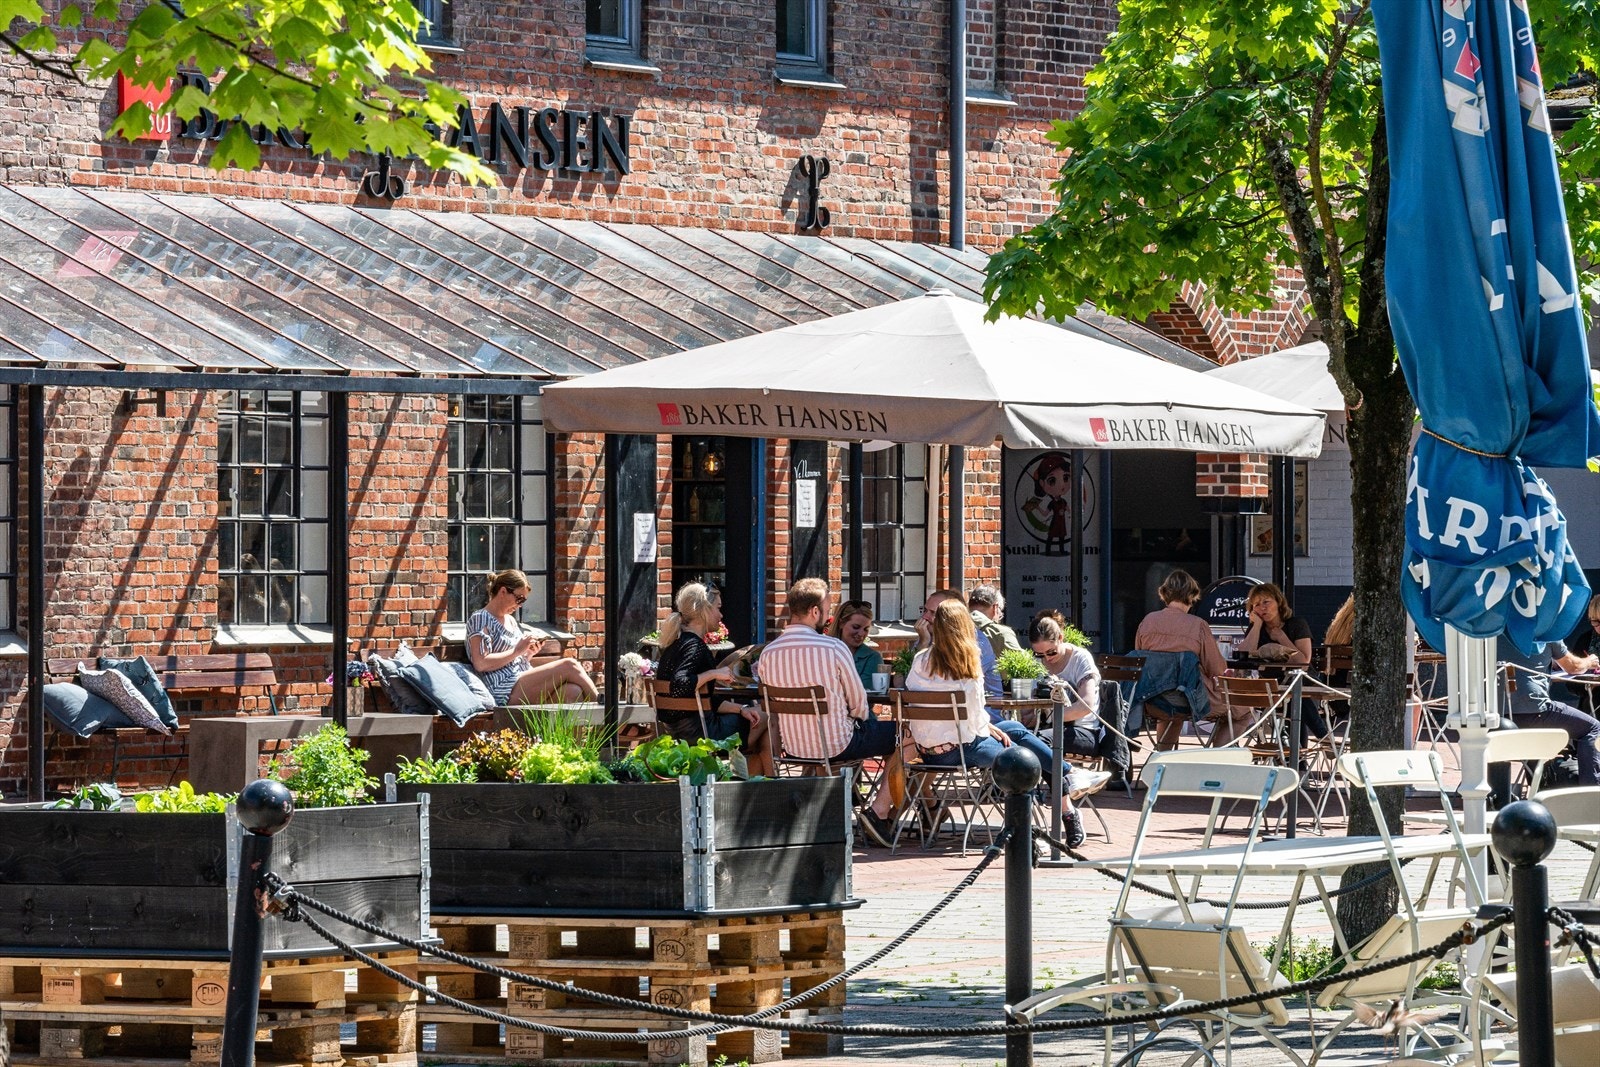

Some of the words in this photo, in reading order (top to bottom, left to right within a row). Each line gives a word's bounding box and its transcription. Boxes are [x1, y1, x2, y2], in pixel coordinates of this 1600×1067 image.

[408, 99, 631, 176] ANSEN
[680, 403, 767, 426] BAKER
[773, 404, 888, 434] HANSEN
[1107, 418, 1171, 442] BAKER
[1176, 419, 1256, 447] HANSEN
[660, 944, 681, 957] EPAL
[659, 993, 680, 1005] EPAL
